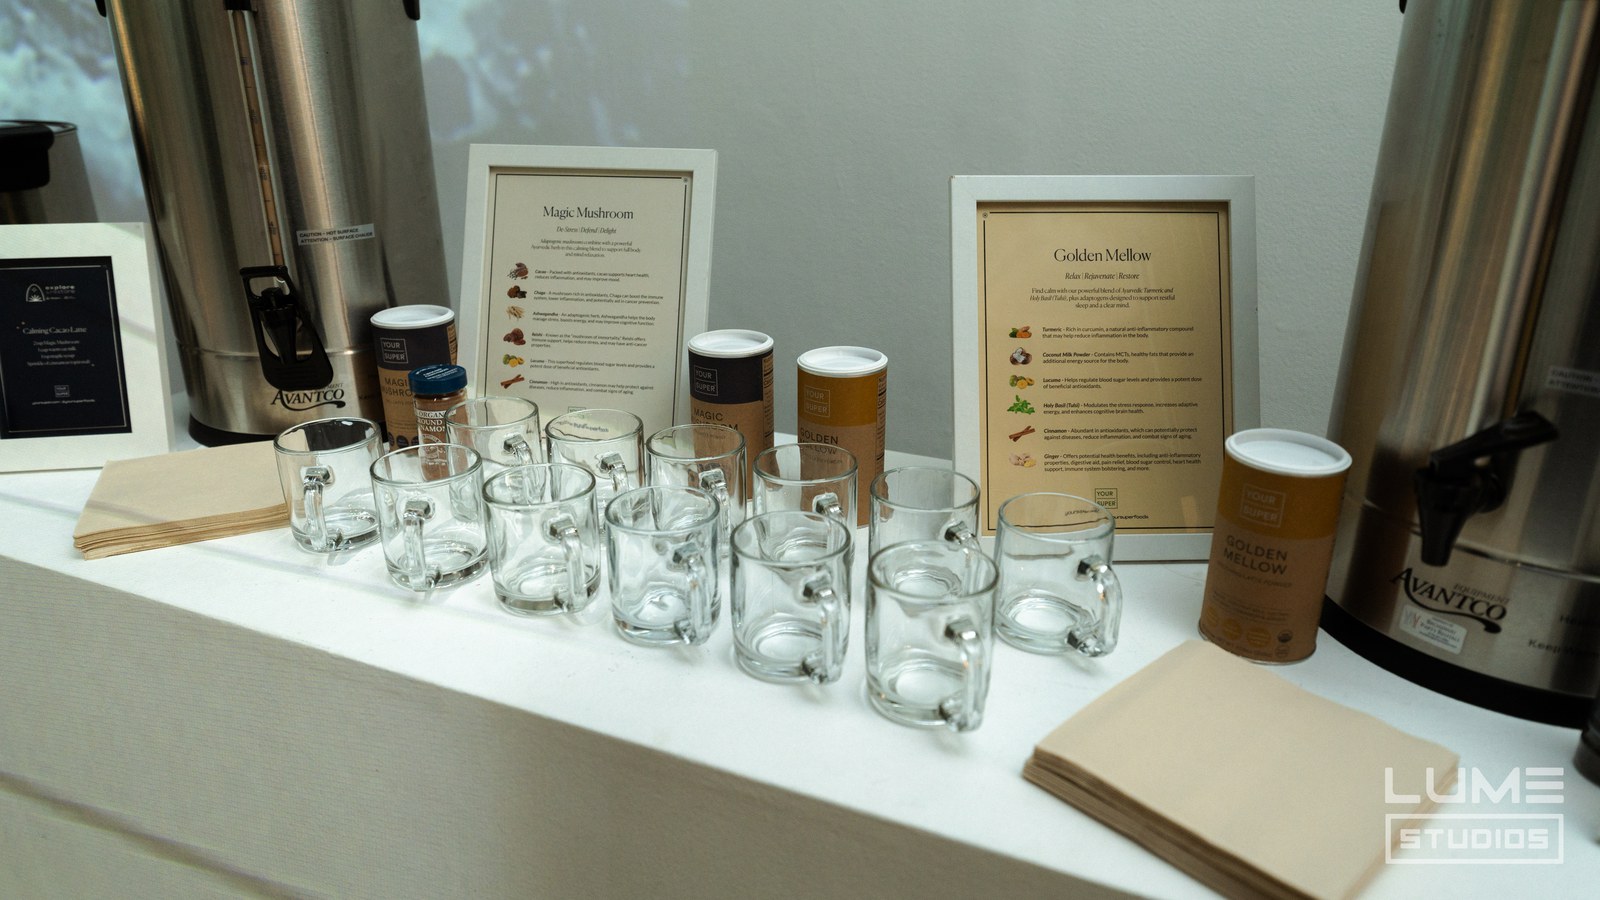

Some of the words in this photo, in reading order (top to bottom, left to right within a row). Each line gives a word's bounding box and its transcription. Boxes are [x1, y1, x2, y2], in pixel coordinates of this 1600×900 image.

[544, 206, 574, 220] Magic
[577, 207, 634, 219] Mushroom
[1054, 248, 1102, 262] Golden
[1106, 248, 1151, 262] Mellow
[1084, 272, 1115, 281] Rejuvenate
[695, 369, 712, 379] YOUR
[384, 378, 408, 387] MAGI
[696, 382, 716, 392] SUPER
[270, 389, 346, 410] AVANTCO
[806, 389, 825, 399] YOUR
[805, 402, 828, 413] SUPER
[694, 408, 723, 421] MAGIC
[800, 428, 838, 444] GOLDEN
[1246, 491, 1276, 504] YOUR
[1243, 505, 1278, 521] SUPER
[1226, 534, 1288, 561] GOLDEN
[1223, 548, 1287, 575] MELLOW
[1389, 568, 1507, 627] AVANTCO
